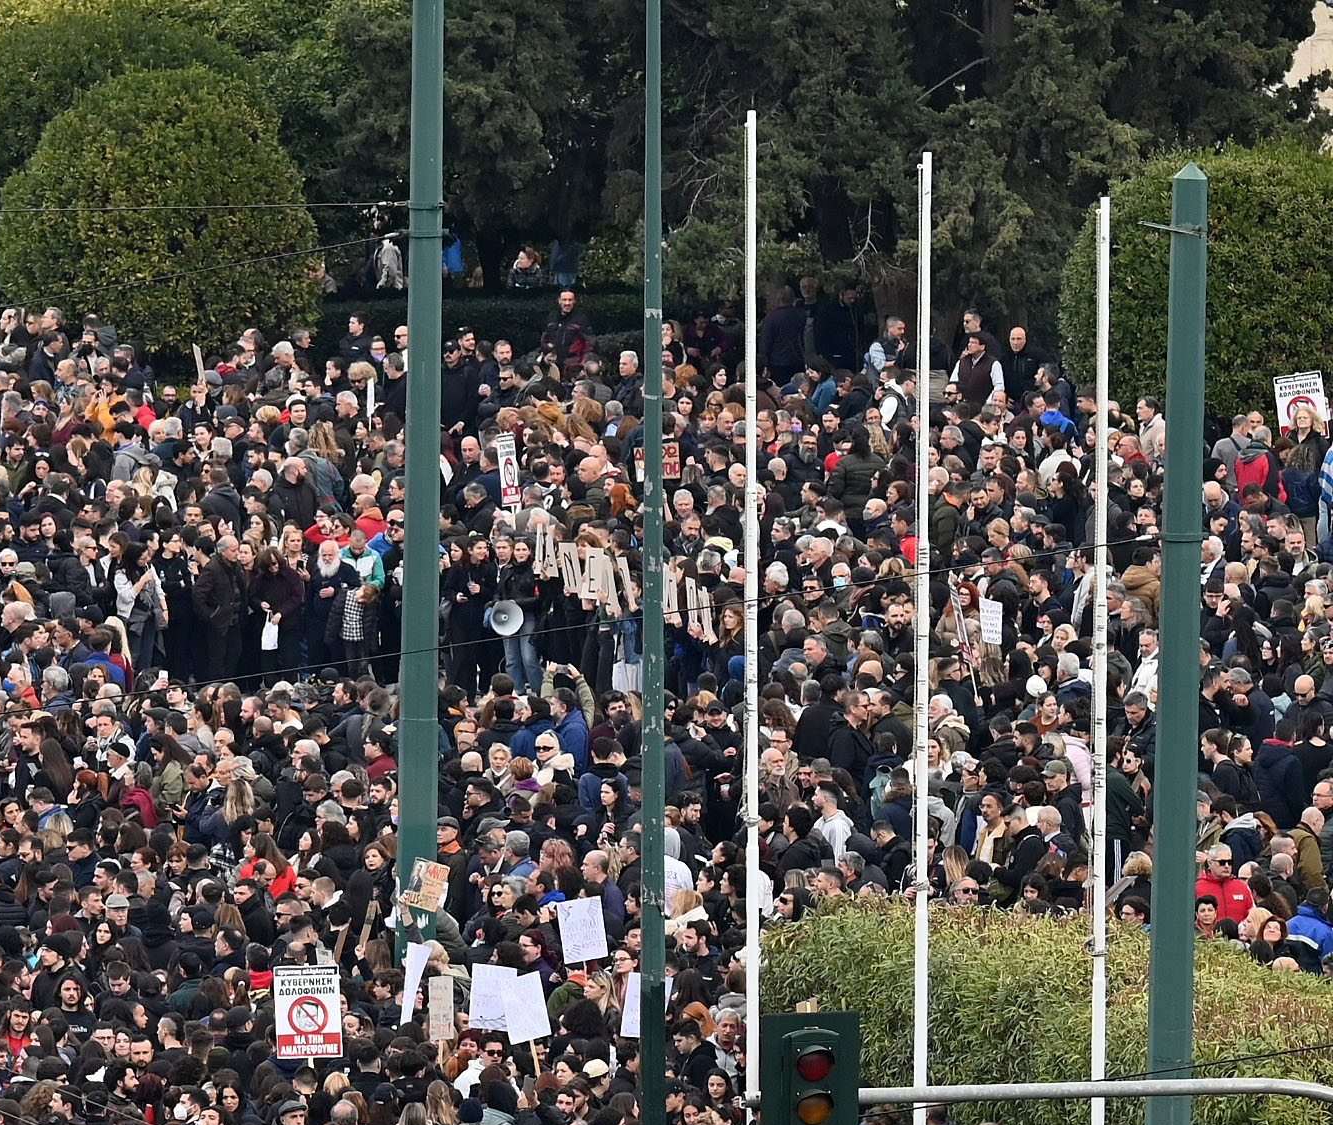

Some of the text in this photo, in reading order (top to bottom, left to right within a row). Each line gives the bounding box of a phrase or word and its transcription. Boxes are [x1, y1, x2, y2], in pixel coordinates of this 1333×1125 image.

[280, 977, 334, 987] ΚΥΒΕΡΝΗΣΗ
[278, 986, 336, 996] ΔΟΛΟΦΟΝΩΝ
[294, 1034, 324, 1045] ΝΑ ΤΗΝ
[280, 1043, 339, 1055] ΑΝΑΤΡΕΨΟΥΜΕ
